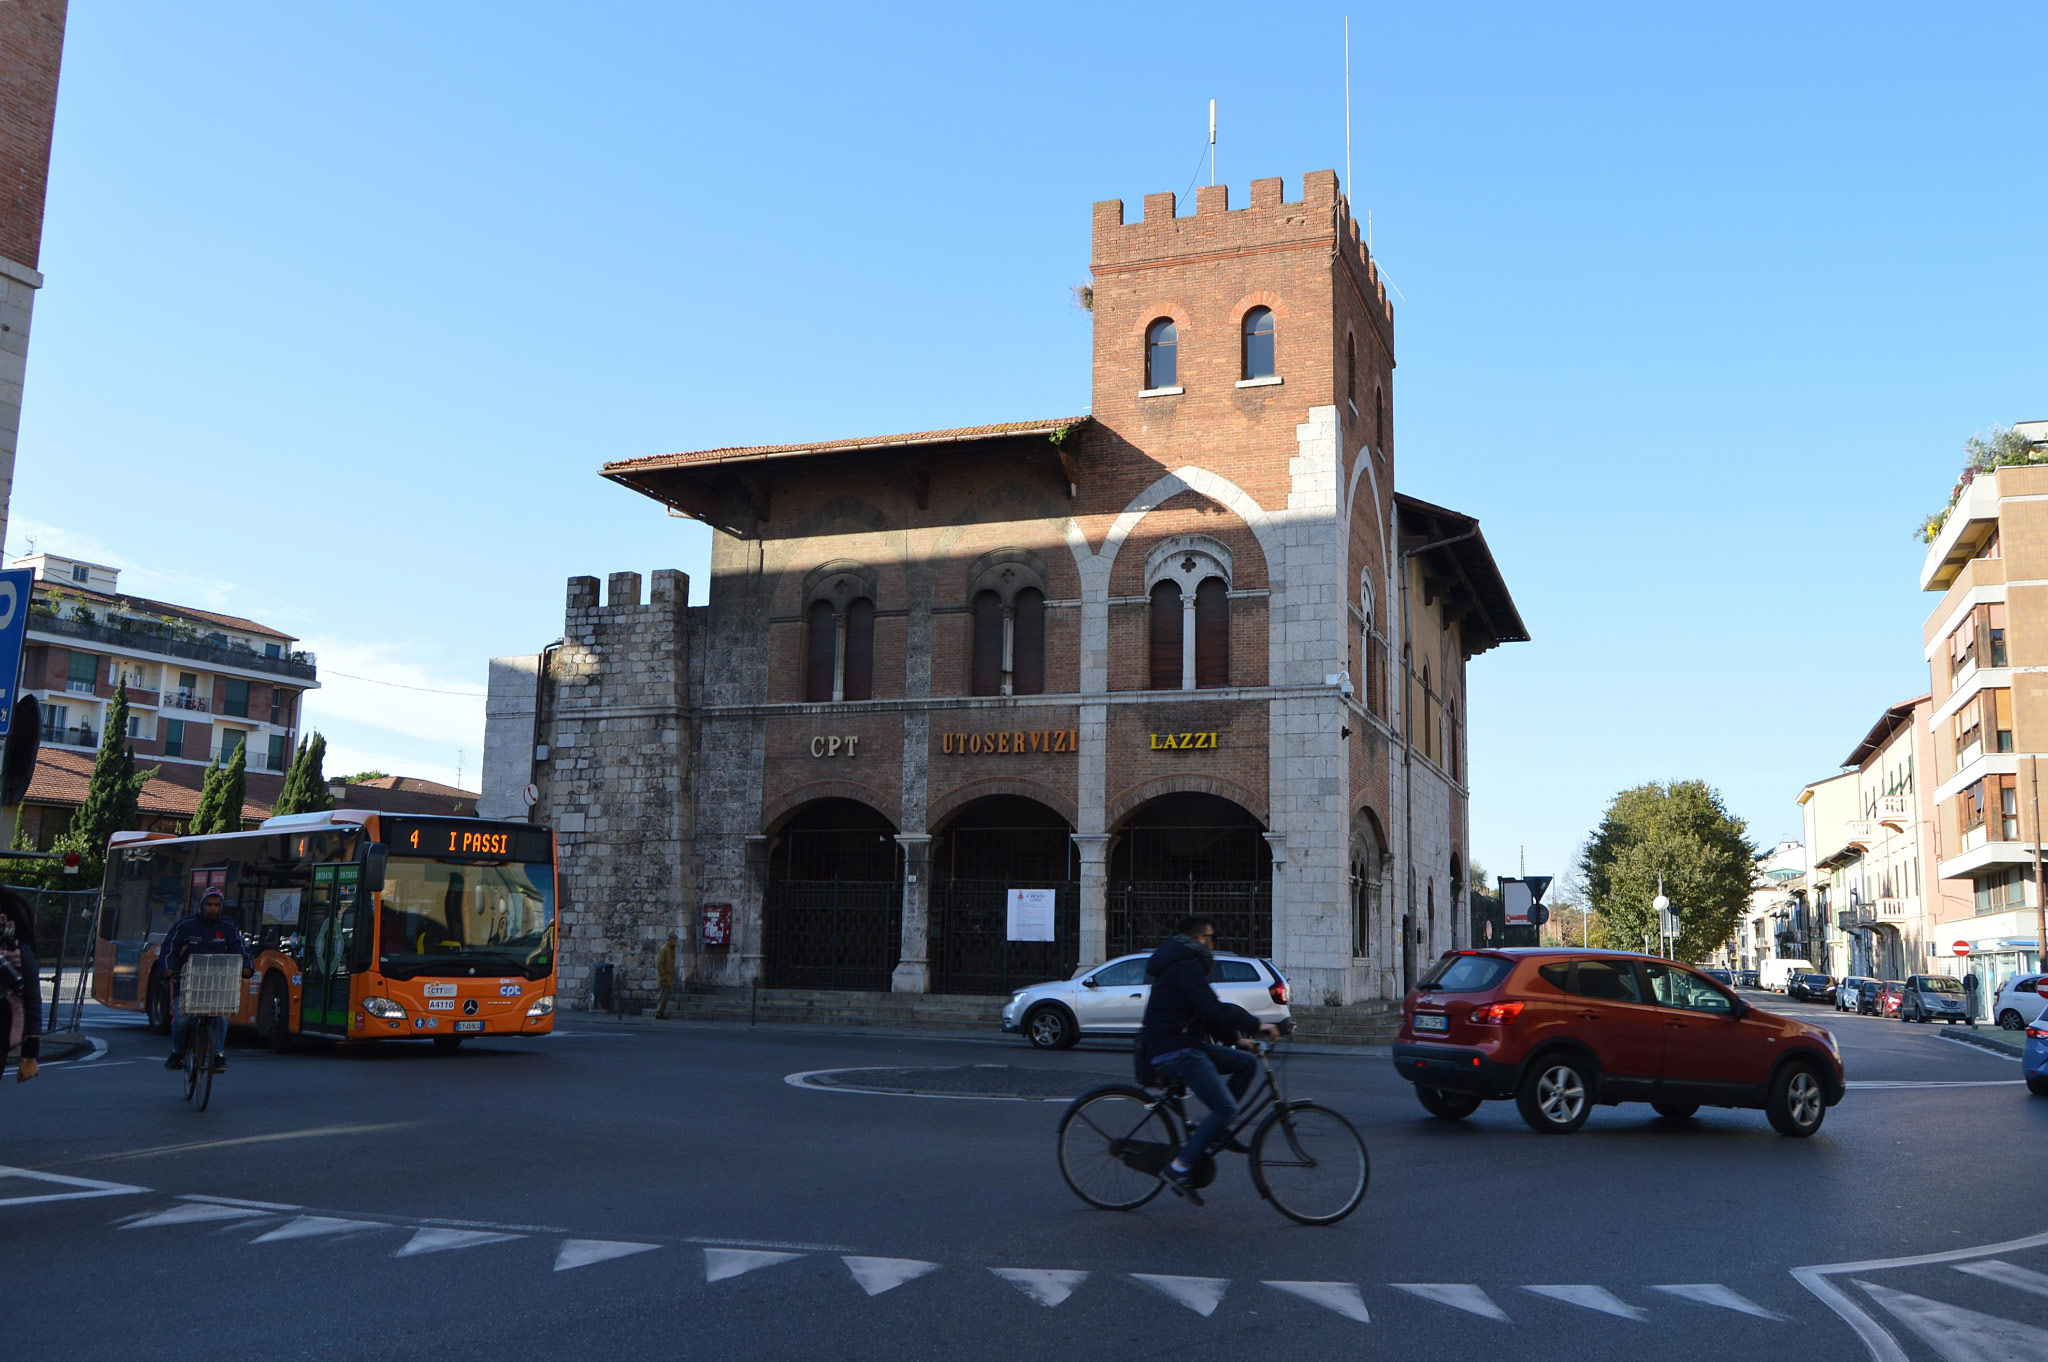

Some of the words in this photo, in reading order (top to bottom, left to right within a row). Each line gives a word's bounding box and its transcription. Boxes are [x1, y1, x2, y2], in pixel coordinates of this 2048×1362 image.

[811, 735, 859, 757] CPT
[942, 729, 1077, 755] UTOSERVIZI
[1150, 732, 1218, 750] LAZZI
[410, 829, 419, 849] 4
[449, 831, 457, 851] I
[463, 832, 508, 854] PASSI
[339, 871, 358, 880] ENTRATA
[500, 985, 521, 996] cpt
[429, 1001, 454, 1009] A4110
